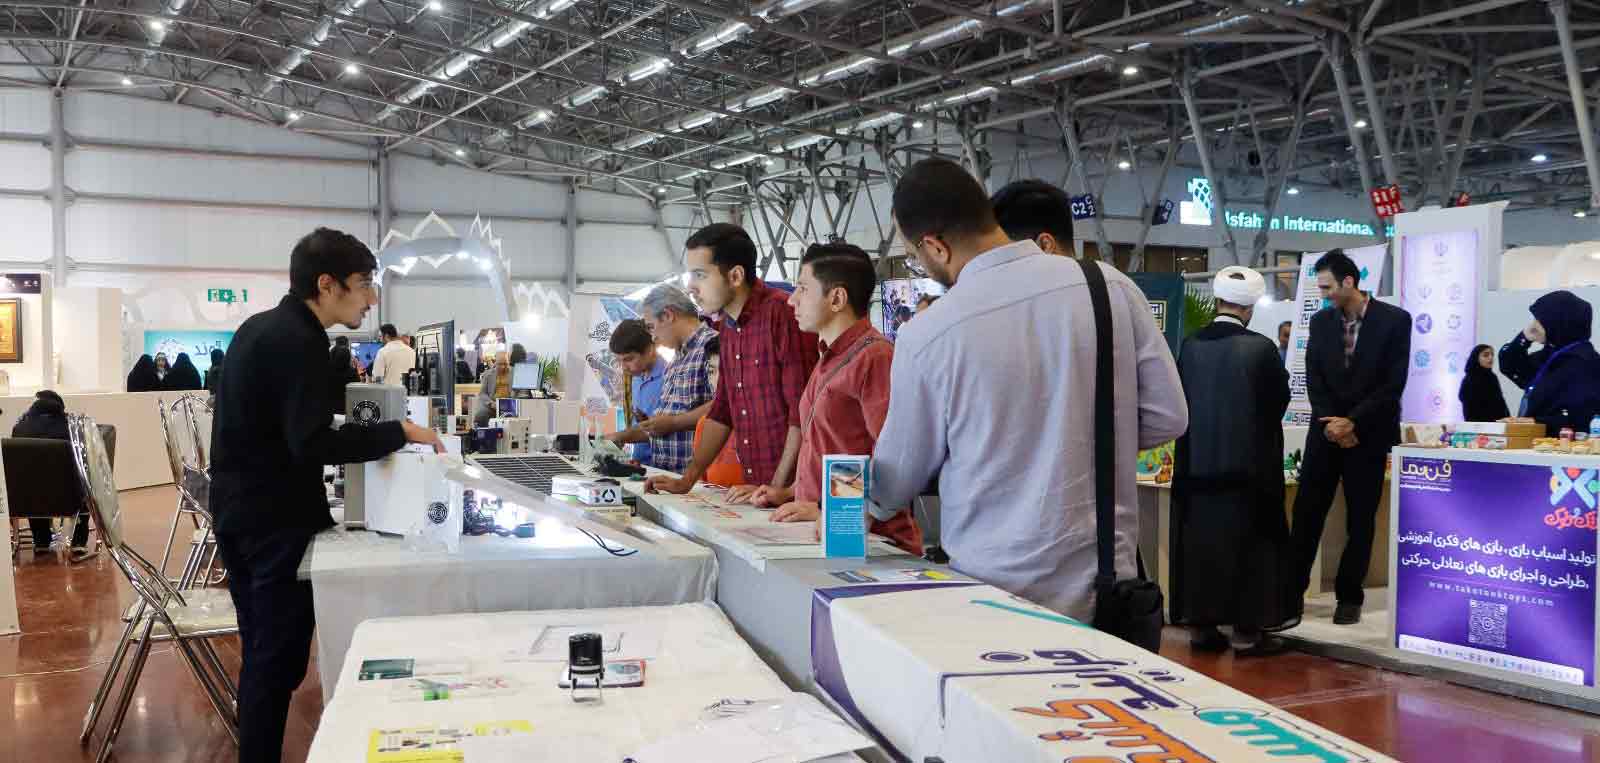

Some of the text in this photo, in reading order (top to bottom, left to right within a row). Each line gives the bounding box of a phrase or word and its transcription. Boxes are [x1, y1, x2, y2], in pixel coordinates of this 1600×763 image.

[1071, 202, 1087, 216] C2
[1226, 211, 1279, 229] Isfahn
[1284, 215, 1378, 236] Internationa
[1398, 530, 1433, 545] آموزشی
[1433, 534, 1460, 548] فکری
[1460, 536, 1481, 551] های
[1482, 539, 1503, 556] بازی
[1531, 545, 1567, 562] اسباب
[1401, 552, 1431, 567] حرکتی
[1431, 555, 1465, 570] تعادلی
[1567, 550, 1596, 567] تولید
[1465, 560, 1487, 576] های
[1487, 563, 1509, 580] بازی
[1509, 566, 1538, 583] اجرای
[1539, 574, 1547, 586] و
